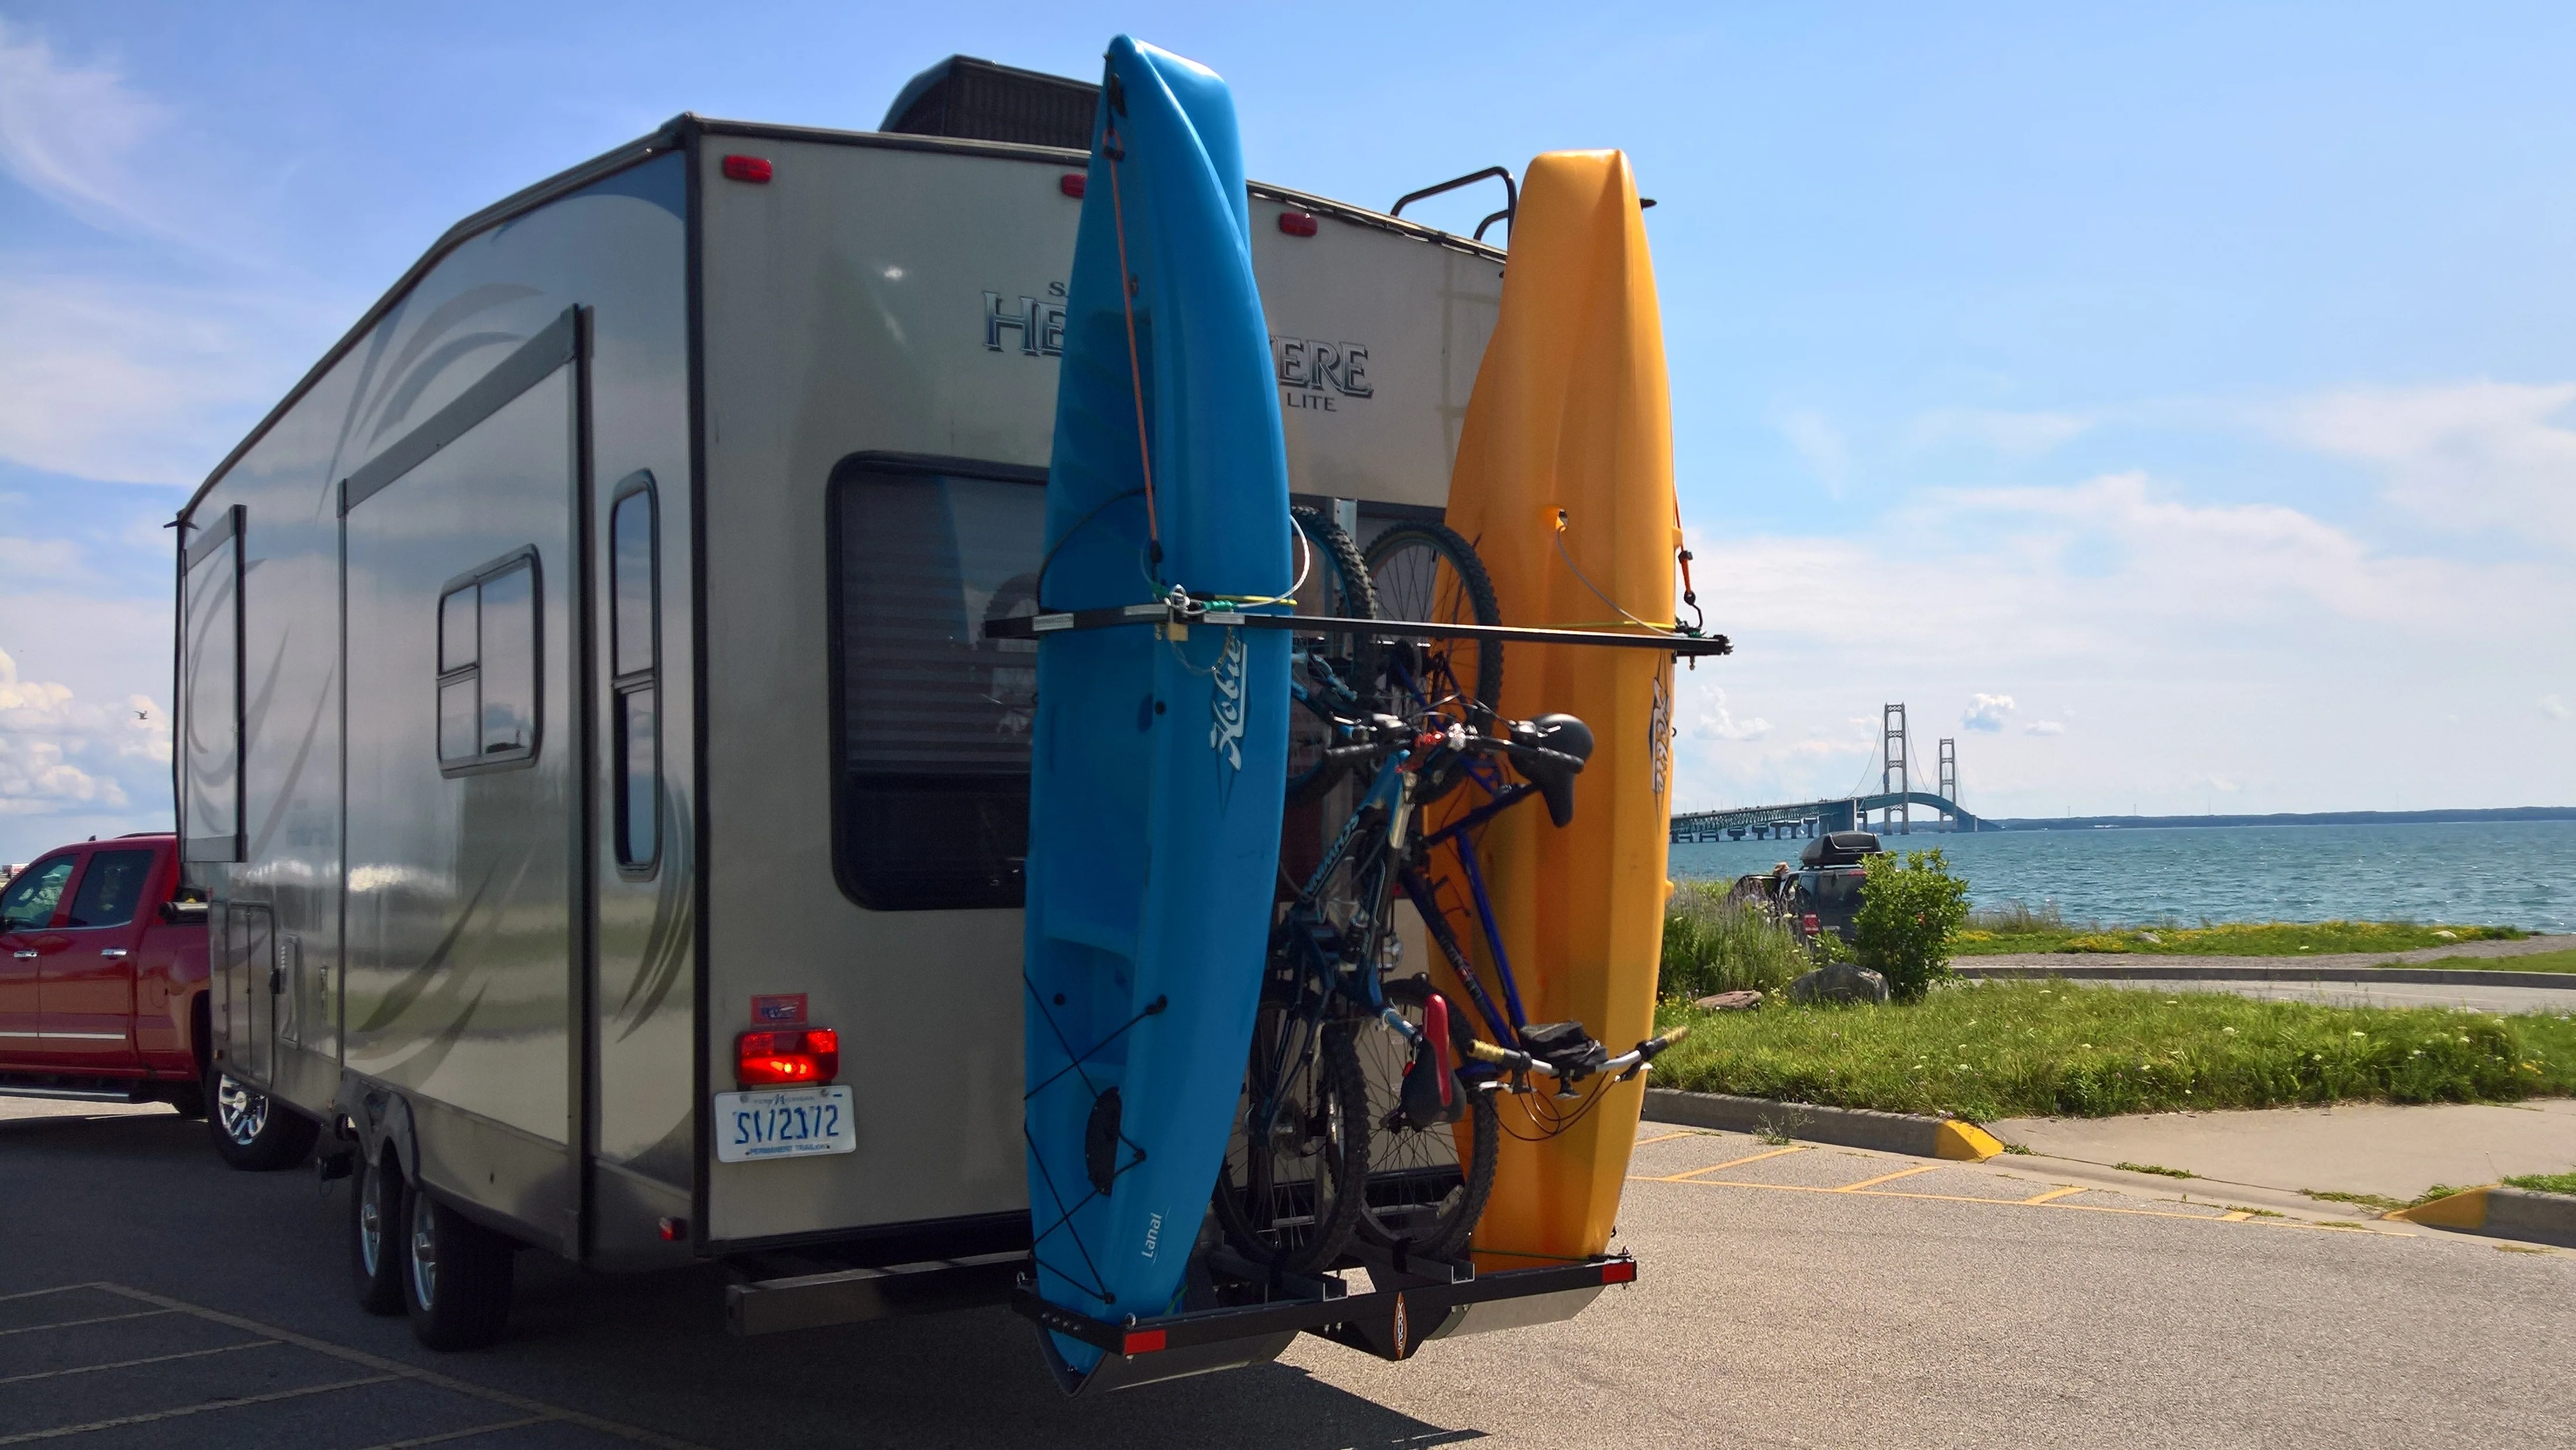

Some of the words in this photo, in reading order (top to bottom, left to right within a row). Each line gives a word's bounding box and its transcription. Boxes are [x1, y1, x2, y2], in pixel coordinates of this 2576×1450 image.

[1270, 334, 1375, 399] ERE
[1287, 392, 1338, 412] LITE
[1140, 1211, 1163, 1259] Lanai
